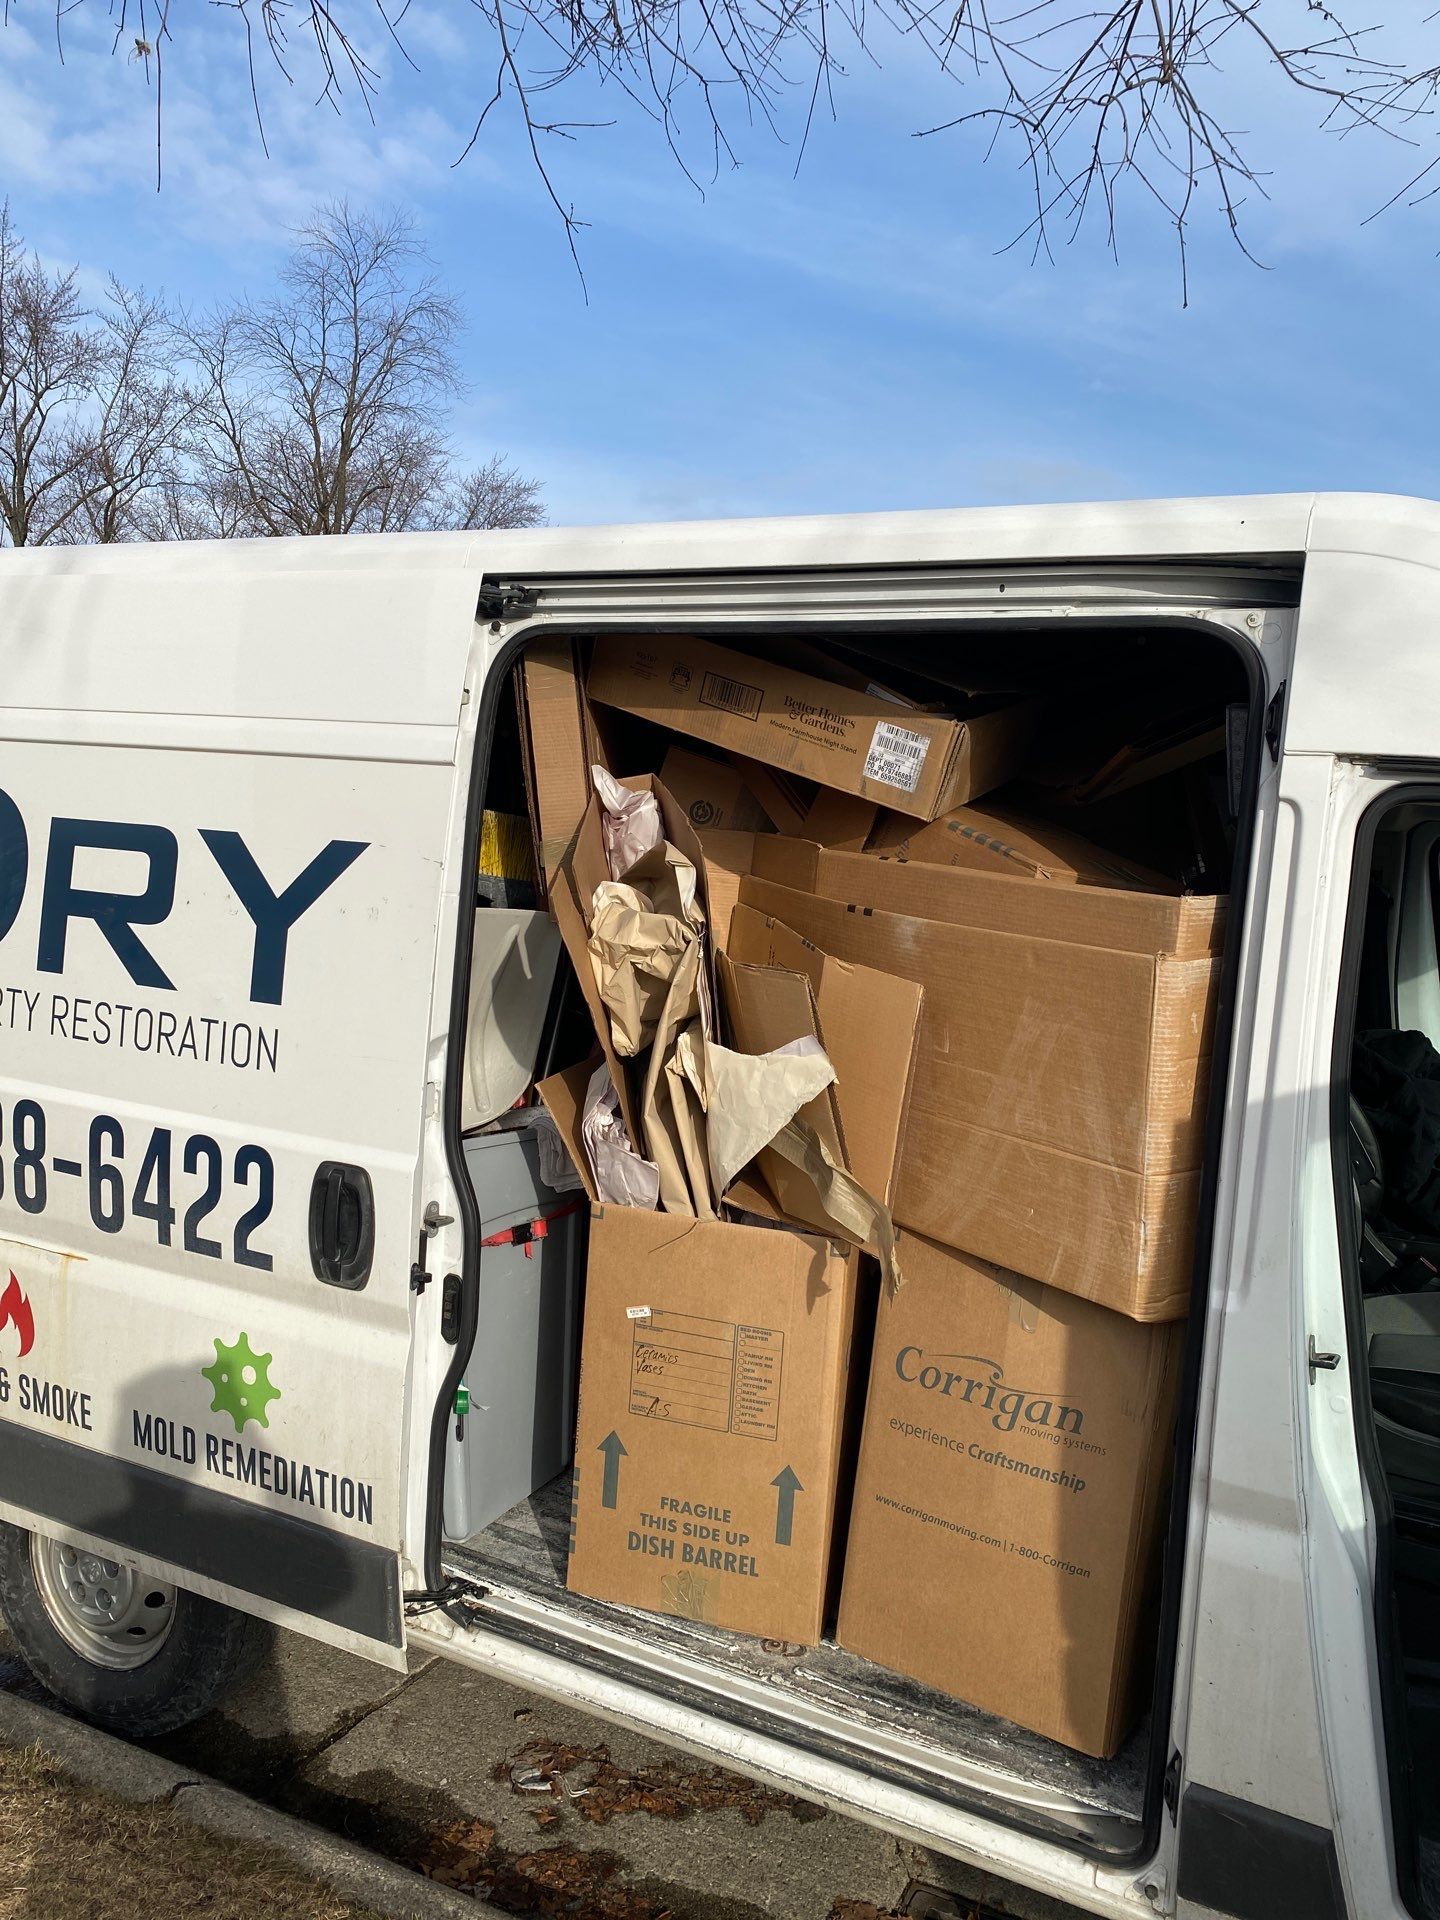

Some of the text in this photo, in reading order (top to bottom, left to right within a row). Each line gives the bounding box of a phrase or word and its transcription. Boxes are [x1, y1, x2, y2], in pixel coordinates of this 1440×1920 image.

[784, 695, 856, 729] Better Homes
[789, 709, 800, 720] &
[769, 719, 792, 732] Modern
[792, 727, 822, 743] Farmhouse
[824, 737, 840, 749] Night
[840, 743, 857, 755] Stand
[868, 754, 883, 763] DEPT
[0, 786, 372, 1006] RY
[0, 986, 279, 1073] TY RESTORATION
[0, 1098, 275, 1273] 8-6422
[636, 1344, 679, 1365] Ceramics
[637, 1358, 664, 1376] Vases
[19, 1373, 93, 1431] SMOKE
[895, 1346, 1084, 1435] Corrigan
[889, 1416, 1087, 1495] experience Craftsmanship
[1019, 1423, 1107, 1457] moving systems
[133, 1409, 373, 1525] MOLD REMEDIATION
[640, 1512, 750, 1547] THIS SIDE UP
[659, 1496, 732, 1524] FRAGILE
[627, 1530, 759, 1578] DISH BARREL
[875, 1493, 1002, 1549] www.corriganmoving.com
[1009, 1542, 1091, 1579] 1-800-Corrigan
